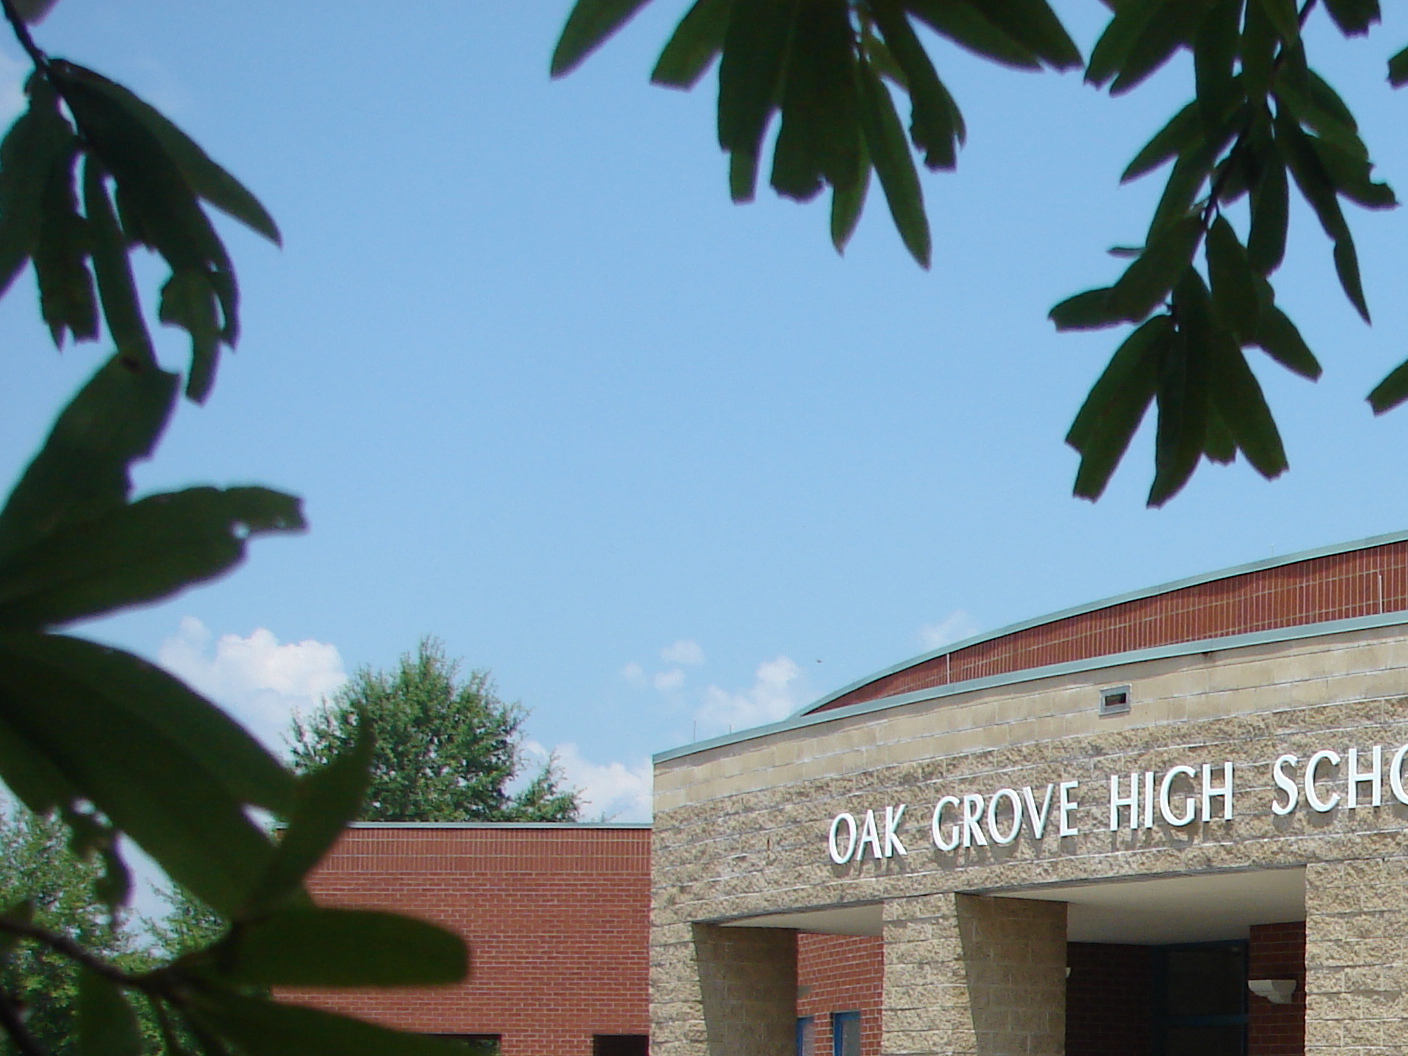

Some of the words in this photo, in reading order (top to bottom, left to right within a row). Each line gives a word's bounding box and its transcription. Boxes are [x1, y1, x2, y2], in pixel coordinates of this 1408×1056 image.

[829, 804, 907, 865] OAK
[933, 781, 1079, 852] GROVE
[1109, 761, 1234, 832] HIGH
